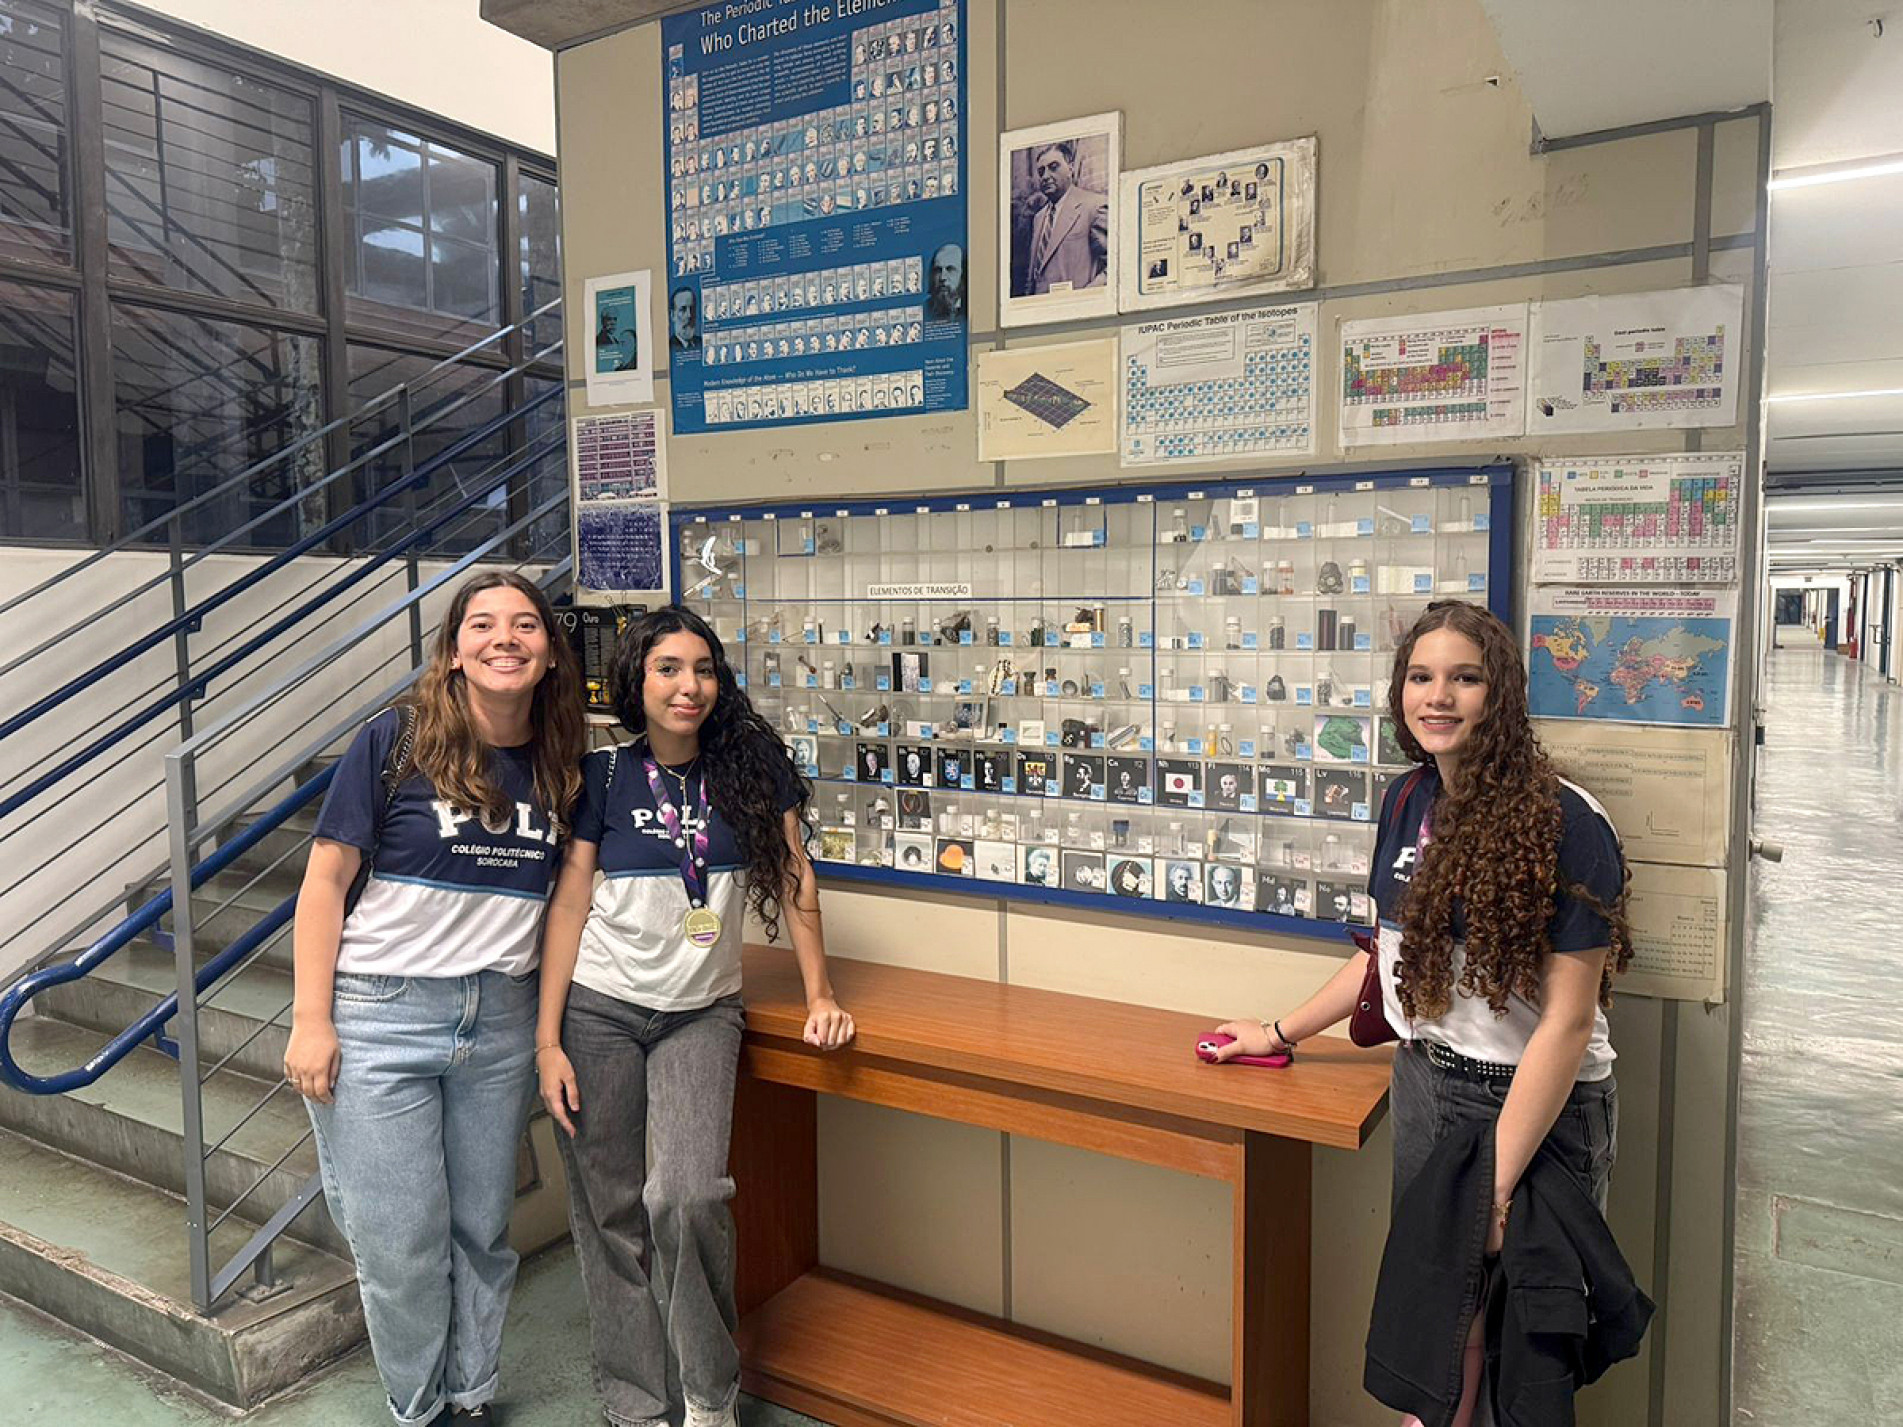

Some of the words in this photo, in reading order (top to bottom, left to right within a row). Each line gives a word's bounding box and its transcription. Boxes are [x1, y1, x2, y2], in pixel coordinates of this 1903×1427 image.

[701, 10, 722, 27] The
[726, 0, 773, 19] Periodic
[700, 31, 733, 55] Who
[738, 9, 797, 45] Charted
[803, 4, 831, 26] the
[837, 0, 896, 18] Eleme
[1138, 323, 1165, 334] IUPAC
[1166, 319, 1202, 330] Periodic
[1204, 316, 1228, 325] Table
[1230, 313, 1240, 322] of
[1242, 312, 1256, 321] the
[1258, 307, 1298, 319] Isotopes
[870, 586, 912, 596] ELEMENTOS
[913, 586, 923, 595] DE
[926, 584, 969, 596] TRANSIÇÃO
[553, 611, 578, 633] 79
[630, 805, 713, 829] PL
[451, 844, 491, 856] COLÉGIO
[476, 857, 518, 868] SOROCABA
